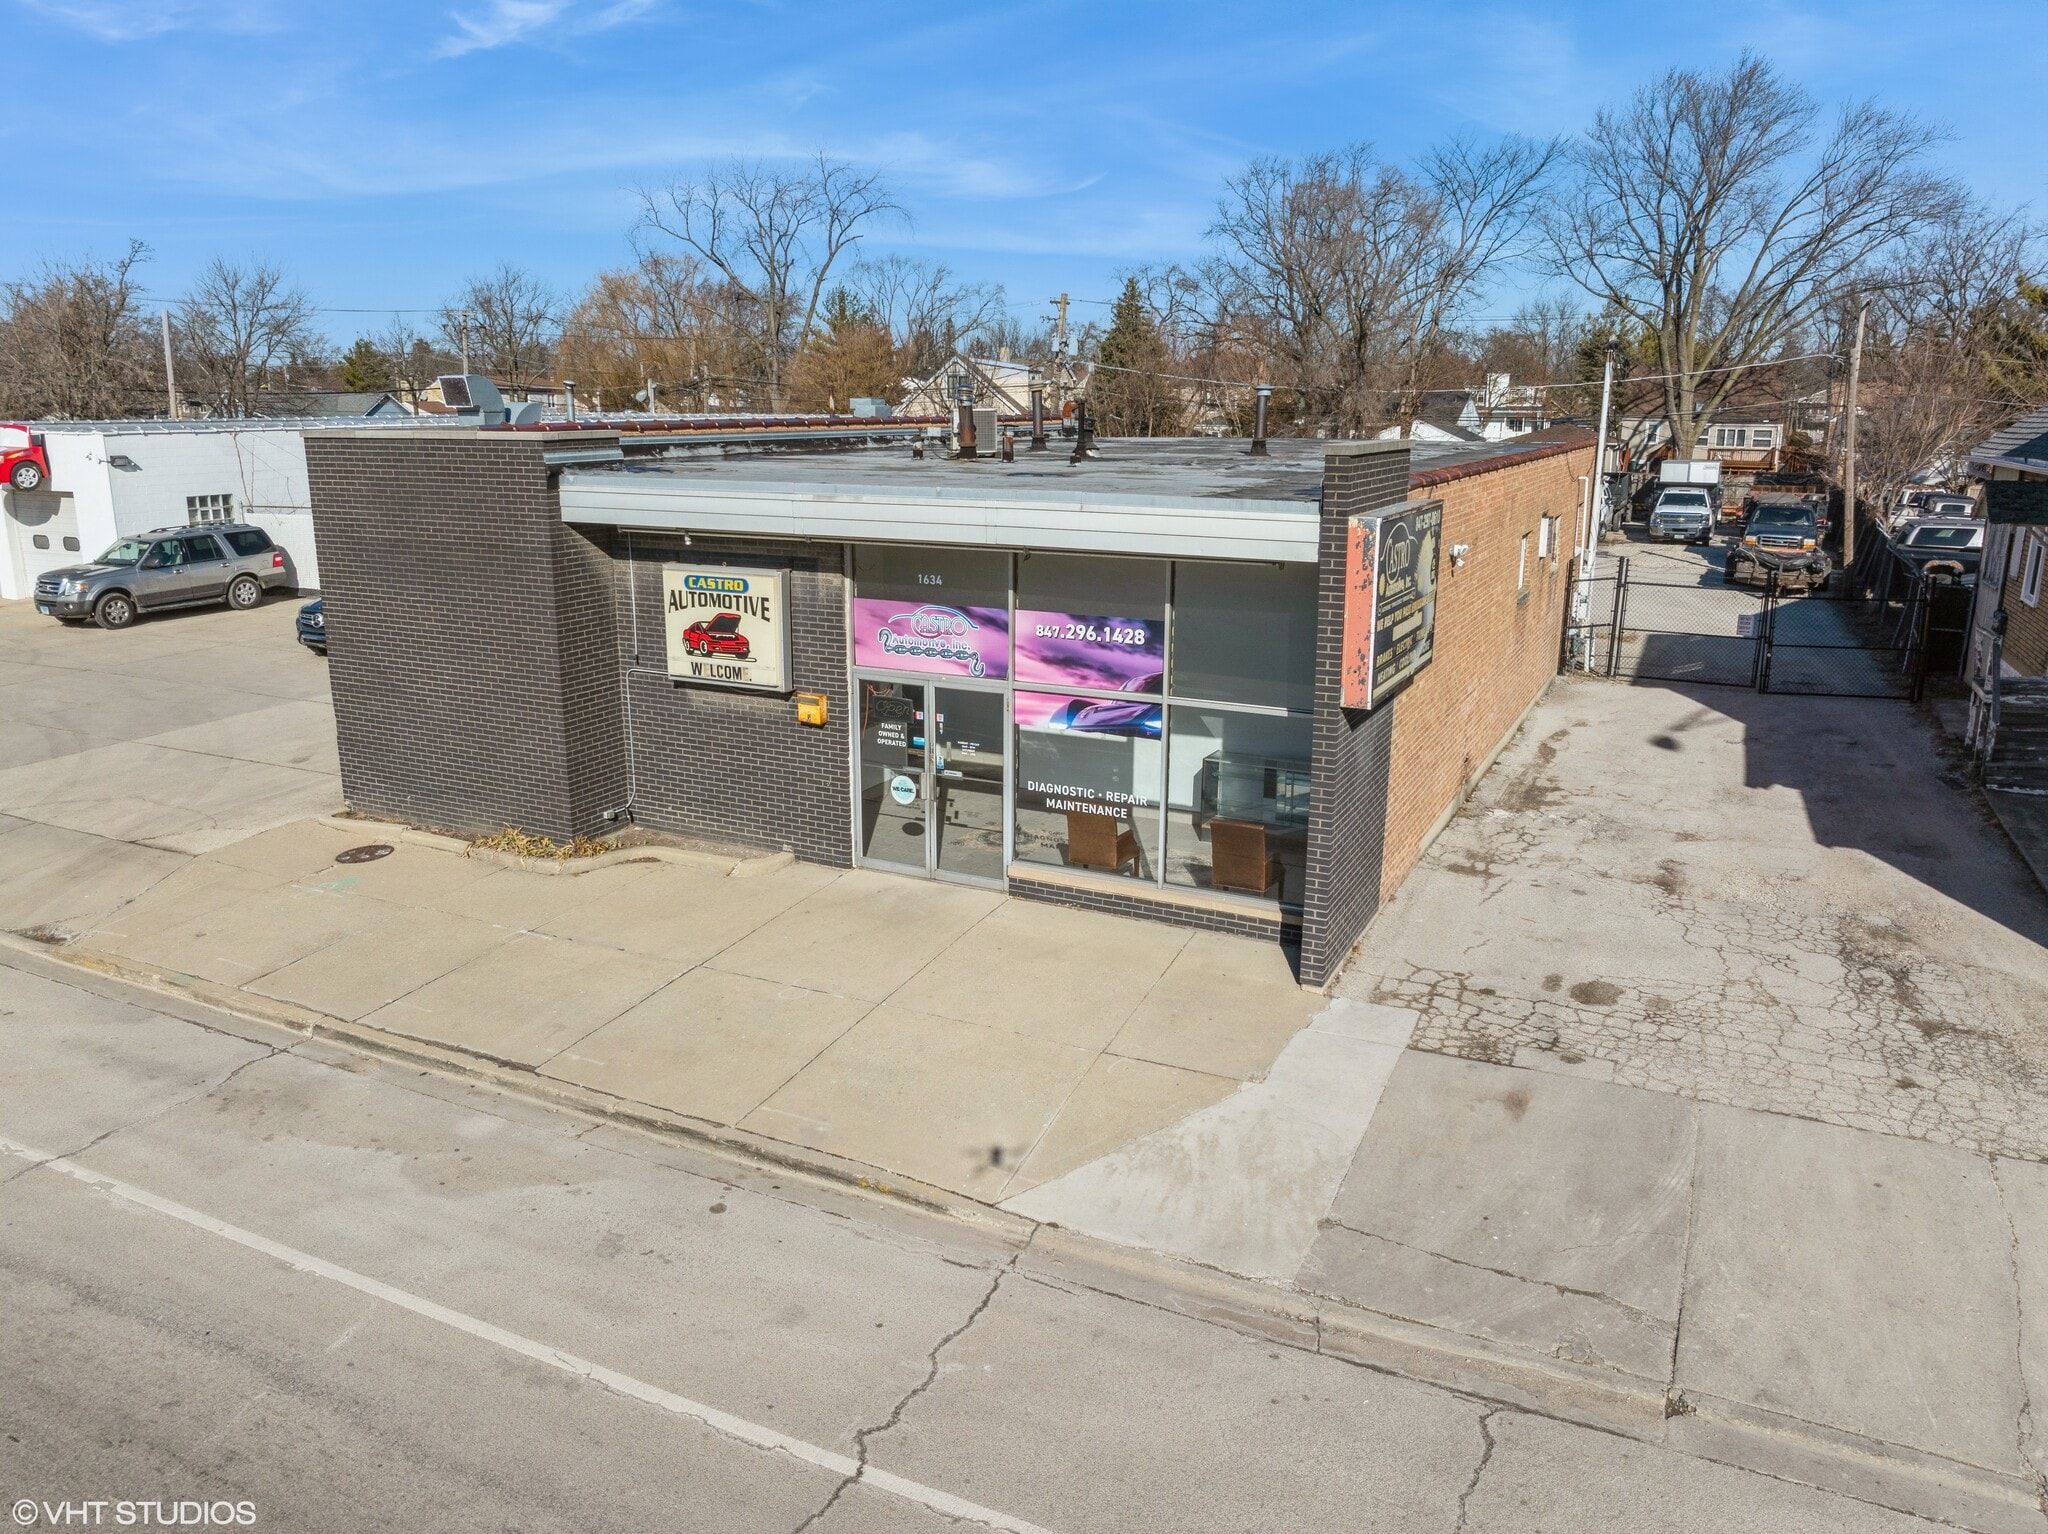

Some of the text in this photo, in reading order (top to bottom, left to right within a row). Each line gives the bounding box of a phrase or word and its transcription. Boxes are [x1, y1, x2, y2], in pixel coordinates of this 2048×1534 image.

[1386, 538, 1411, 585] CASTRO
[687, 576, 745, 592] CASTRO
[918, 573, 943, 585] 1634
[668, 589, 771, 623] AUTOMOTIVE
[911, 612, 968, 639] CASTRO
[1036, 623, 1146, 645] 847.296.1428
[878, 730, 900, 738] OWNED
[881, 722, 902, 731] FAMILY
[877, 738, 907, 748] OPERATED
[1027, 780, 1148, 807] DIAGNOSTIC REPAIR
[1046, 798, 1128, 819] MAINTENANCE
